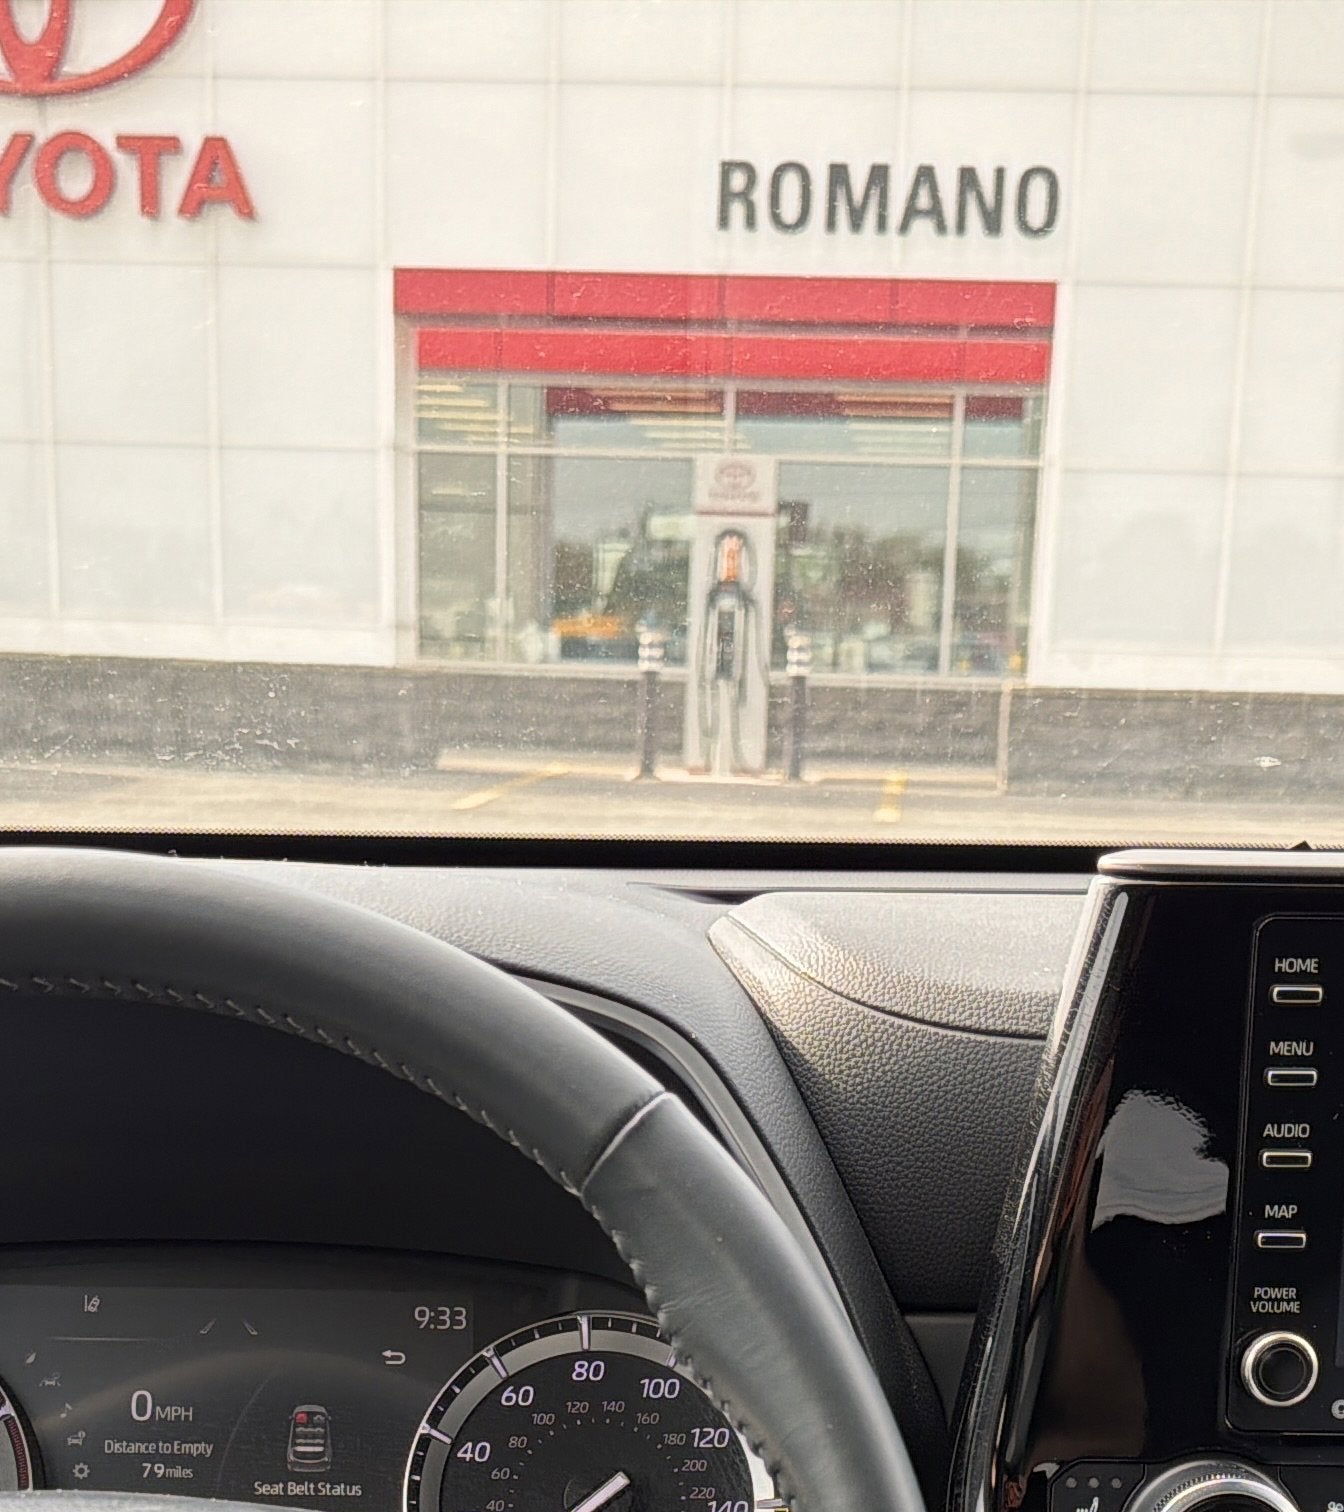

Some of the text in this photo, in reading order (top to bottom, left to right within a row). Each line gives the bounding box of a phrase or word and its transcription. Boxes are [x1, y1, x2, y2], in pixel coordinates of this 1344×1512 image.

[716, 159, 1061, 238] ROMANO
[1274, 958, 1319, 974] HOME
[1269, 1041, 1314, 1057] MENU
[1263, 1123, 1310, 1139] AUDIO
[1265, 1204, 1297, 1220] MAP
[1254, 1287, 1296, 1300] POWER
[1250, 1300, 1300, 1314] VOLUME
[414, 1306, 467, 1331] 9:33
[572, 1361, 605, 1382] 80
[500, 1385, 534, 1408] 60
[640, 1378, 681, 1399] 100
[130, 1390, 193, 1422] 0 MPH
[565, 1401, 590, 1414] 120
[601, 1400, 625, 1414] 140
[531, 1413, 555, 1426] 100
[636, 1412, 660, 1425] 160
[508, 1436, 528, 1449] 80
[663, 1433, 686, 1446] 180
[690, 1427, 730, 1449] 120
[104, 1439, 213, 1459] Distance to Empty
[457, 1441, 491, 1463] 40
[141, 1464, 194, 1479] 79 miles
[490, 1468, 510, 1481] 60
[681, 1460, 707, 1473] 200
[254, 1481, 362, 1498] Seat Belt Status
[689, 1486, 715, 1500] 220
[485, 1500, 505, 1512] 40
